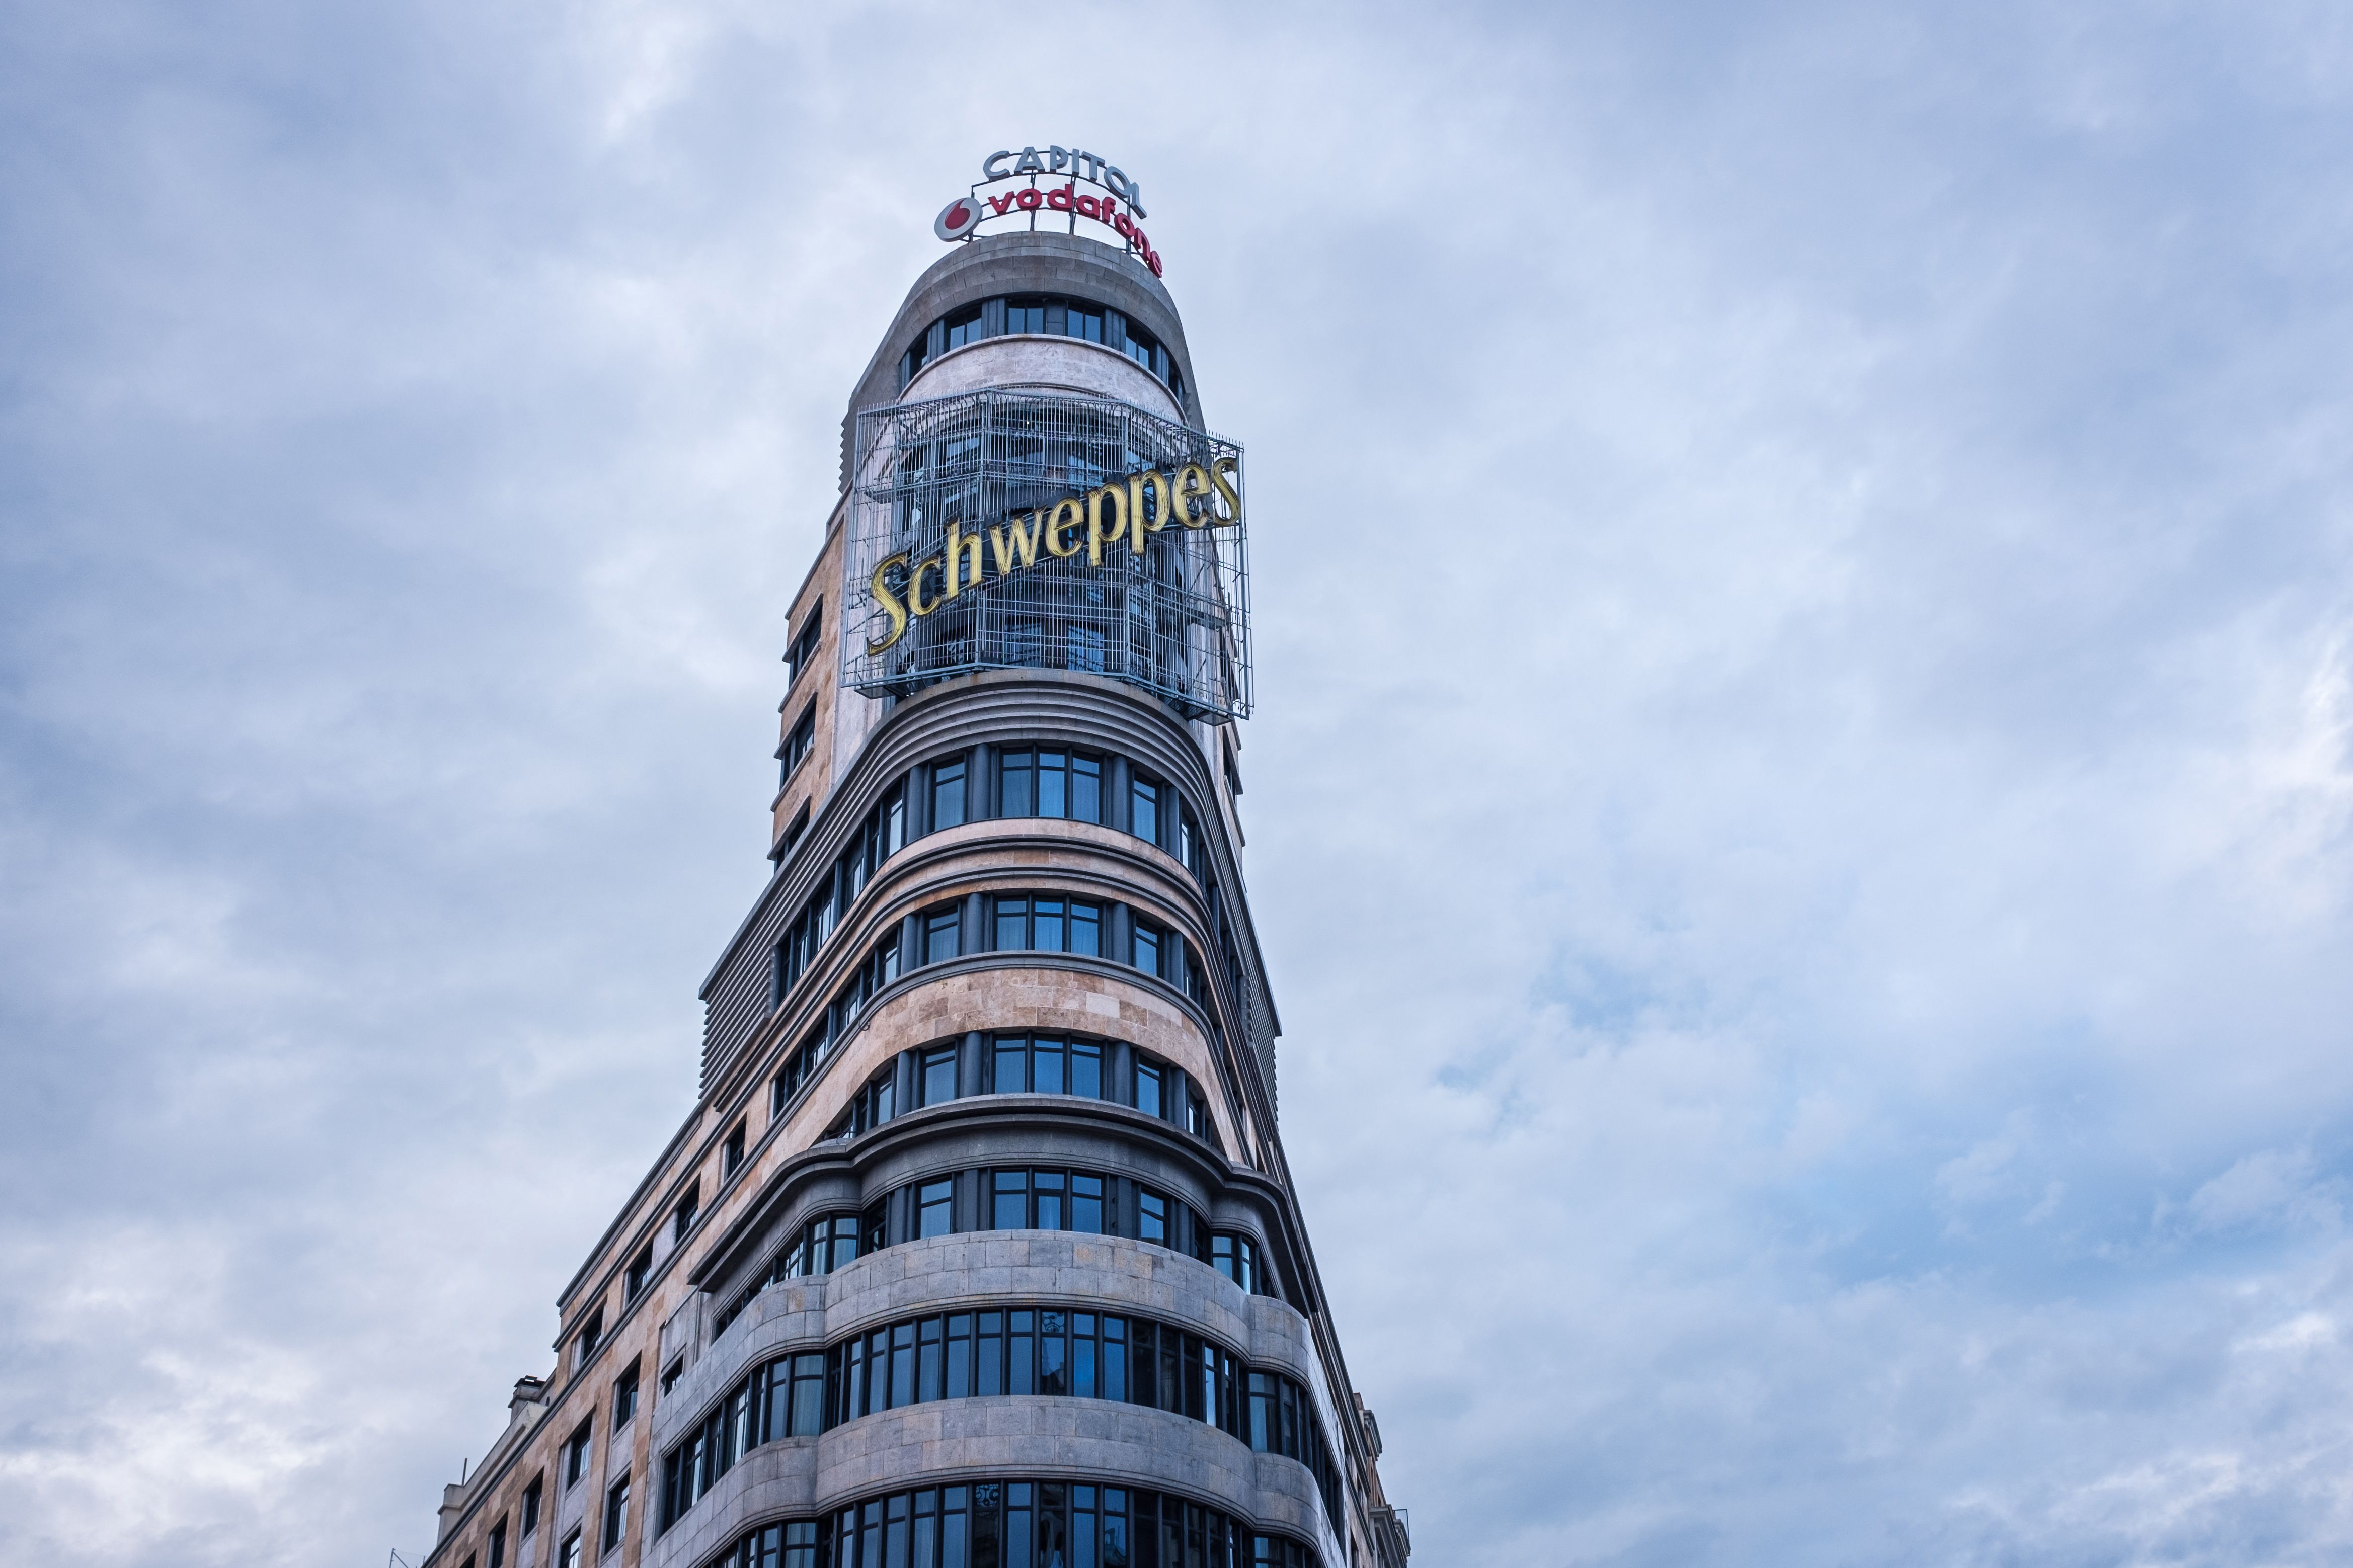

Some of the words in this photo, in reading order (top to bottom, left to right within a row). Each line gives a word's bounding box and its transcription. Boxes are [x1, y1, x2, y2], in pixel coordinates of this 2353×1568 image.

[983, 145, 1147, 219] CAPITOL
[988, 184, 1162, 278] vodafone
[867, 457, 1241, 656] Schweppes
